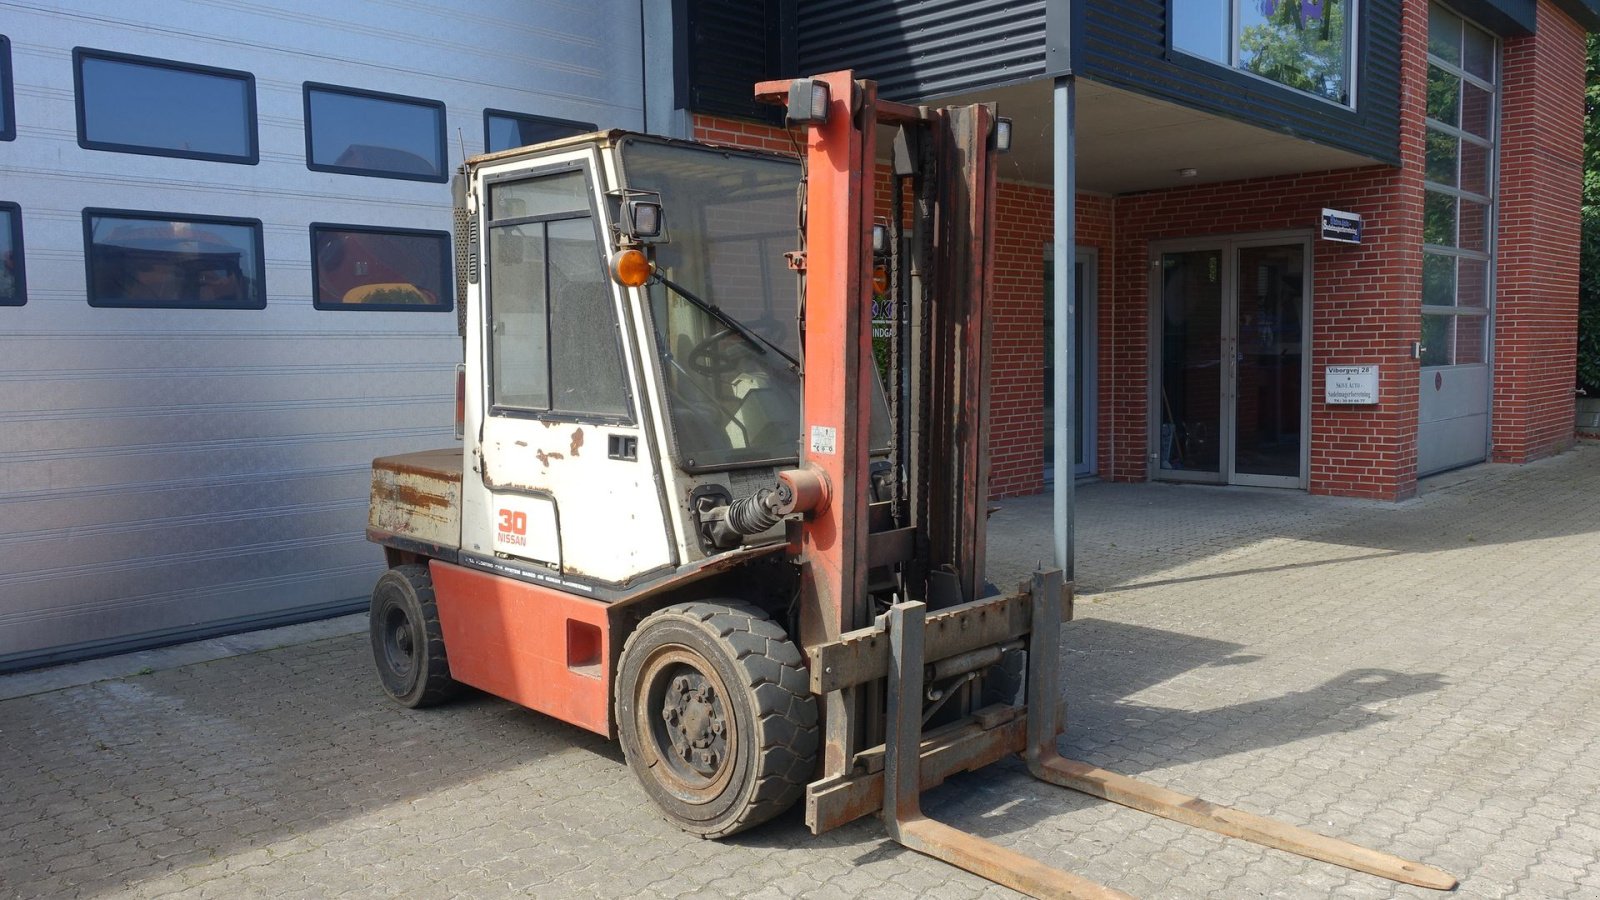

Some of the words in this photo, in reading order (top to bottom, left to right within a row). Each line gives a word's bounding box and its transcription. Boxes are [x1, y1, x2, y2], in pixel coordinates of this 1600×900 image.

[1328, 367, 1360, 375] Viborgvej
[498, 509, 527, 535] 30
[498, 533, 526, 546] NISSAN
